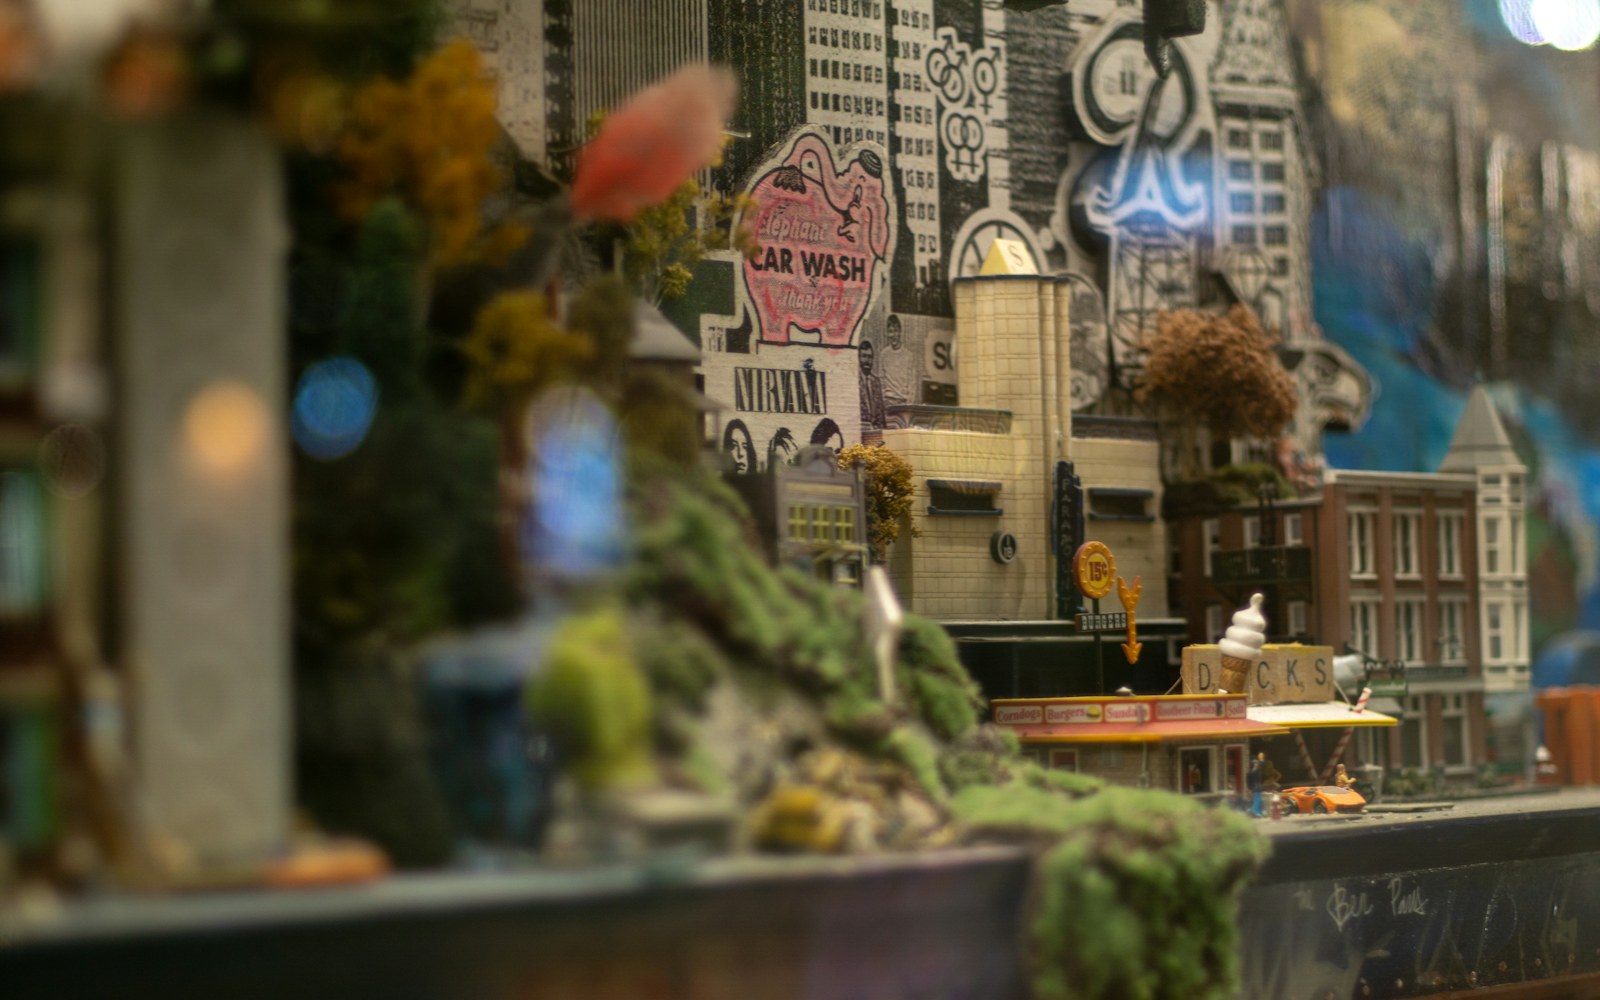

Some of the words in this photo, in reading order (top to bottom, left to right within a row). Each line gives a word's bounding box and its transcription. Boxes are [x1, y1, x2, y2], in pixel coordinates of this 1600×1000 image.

[750, 246, 794, 274] CAR
[800, 250, 866, 283] WASH
[735, 367, 827, 415] NIRVANA
[1198, 658, 1327, 691] DCKS
[996, 708, 1041, 723] Corndogs
[1046, 706, 1085, 722] Burgers
